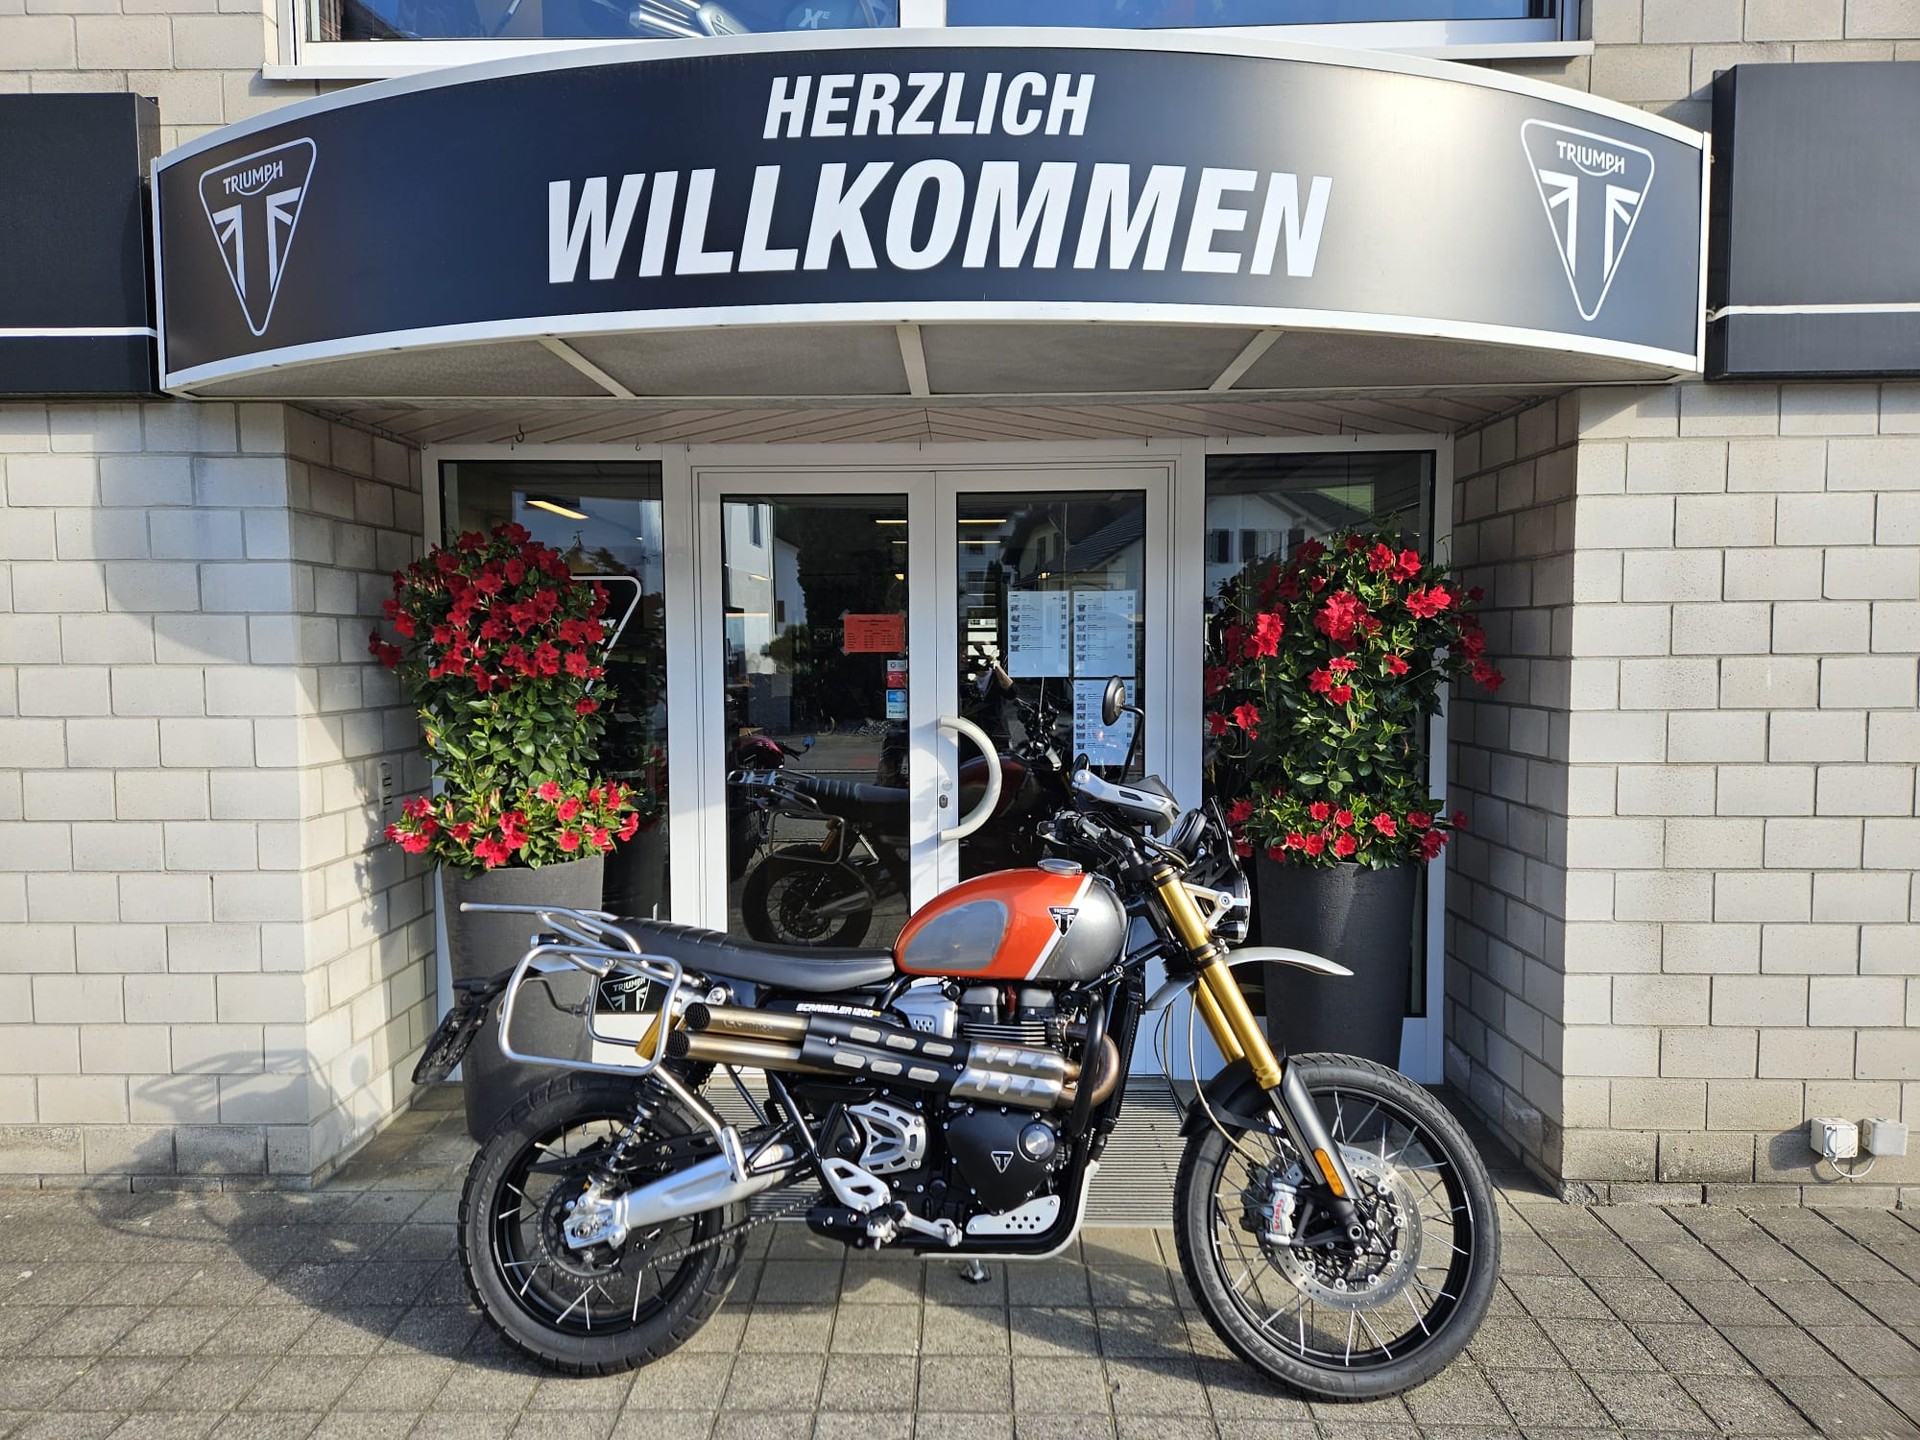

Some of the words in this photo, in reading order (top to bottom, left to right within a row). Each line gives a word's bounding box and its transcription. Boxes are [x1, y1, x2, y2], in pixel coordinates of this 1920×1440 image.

[764, 72, 1094, 138] HERZLICH
[222, 160, 284, 195] TRIUMPH
[1555, 140, 1626, 176] TRIUMPH
[549, 160, 1333, 283] WILLKOMMEN
[612, 976, 646, 992] TRIUMPH
[796, 1003, 852, 1015] SCRAMBLER
[852, 1007, 874, 1017] 1200
[1376, 1079, 1444, 1128] ANAKEE
[1217, 1303, 1313, 1386] MICHELIN
